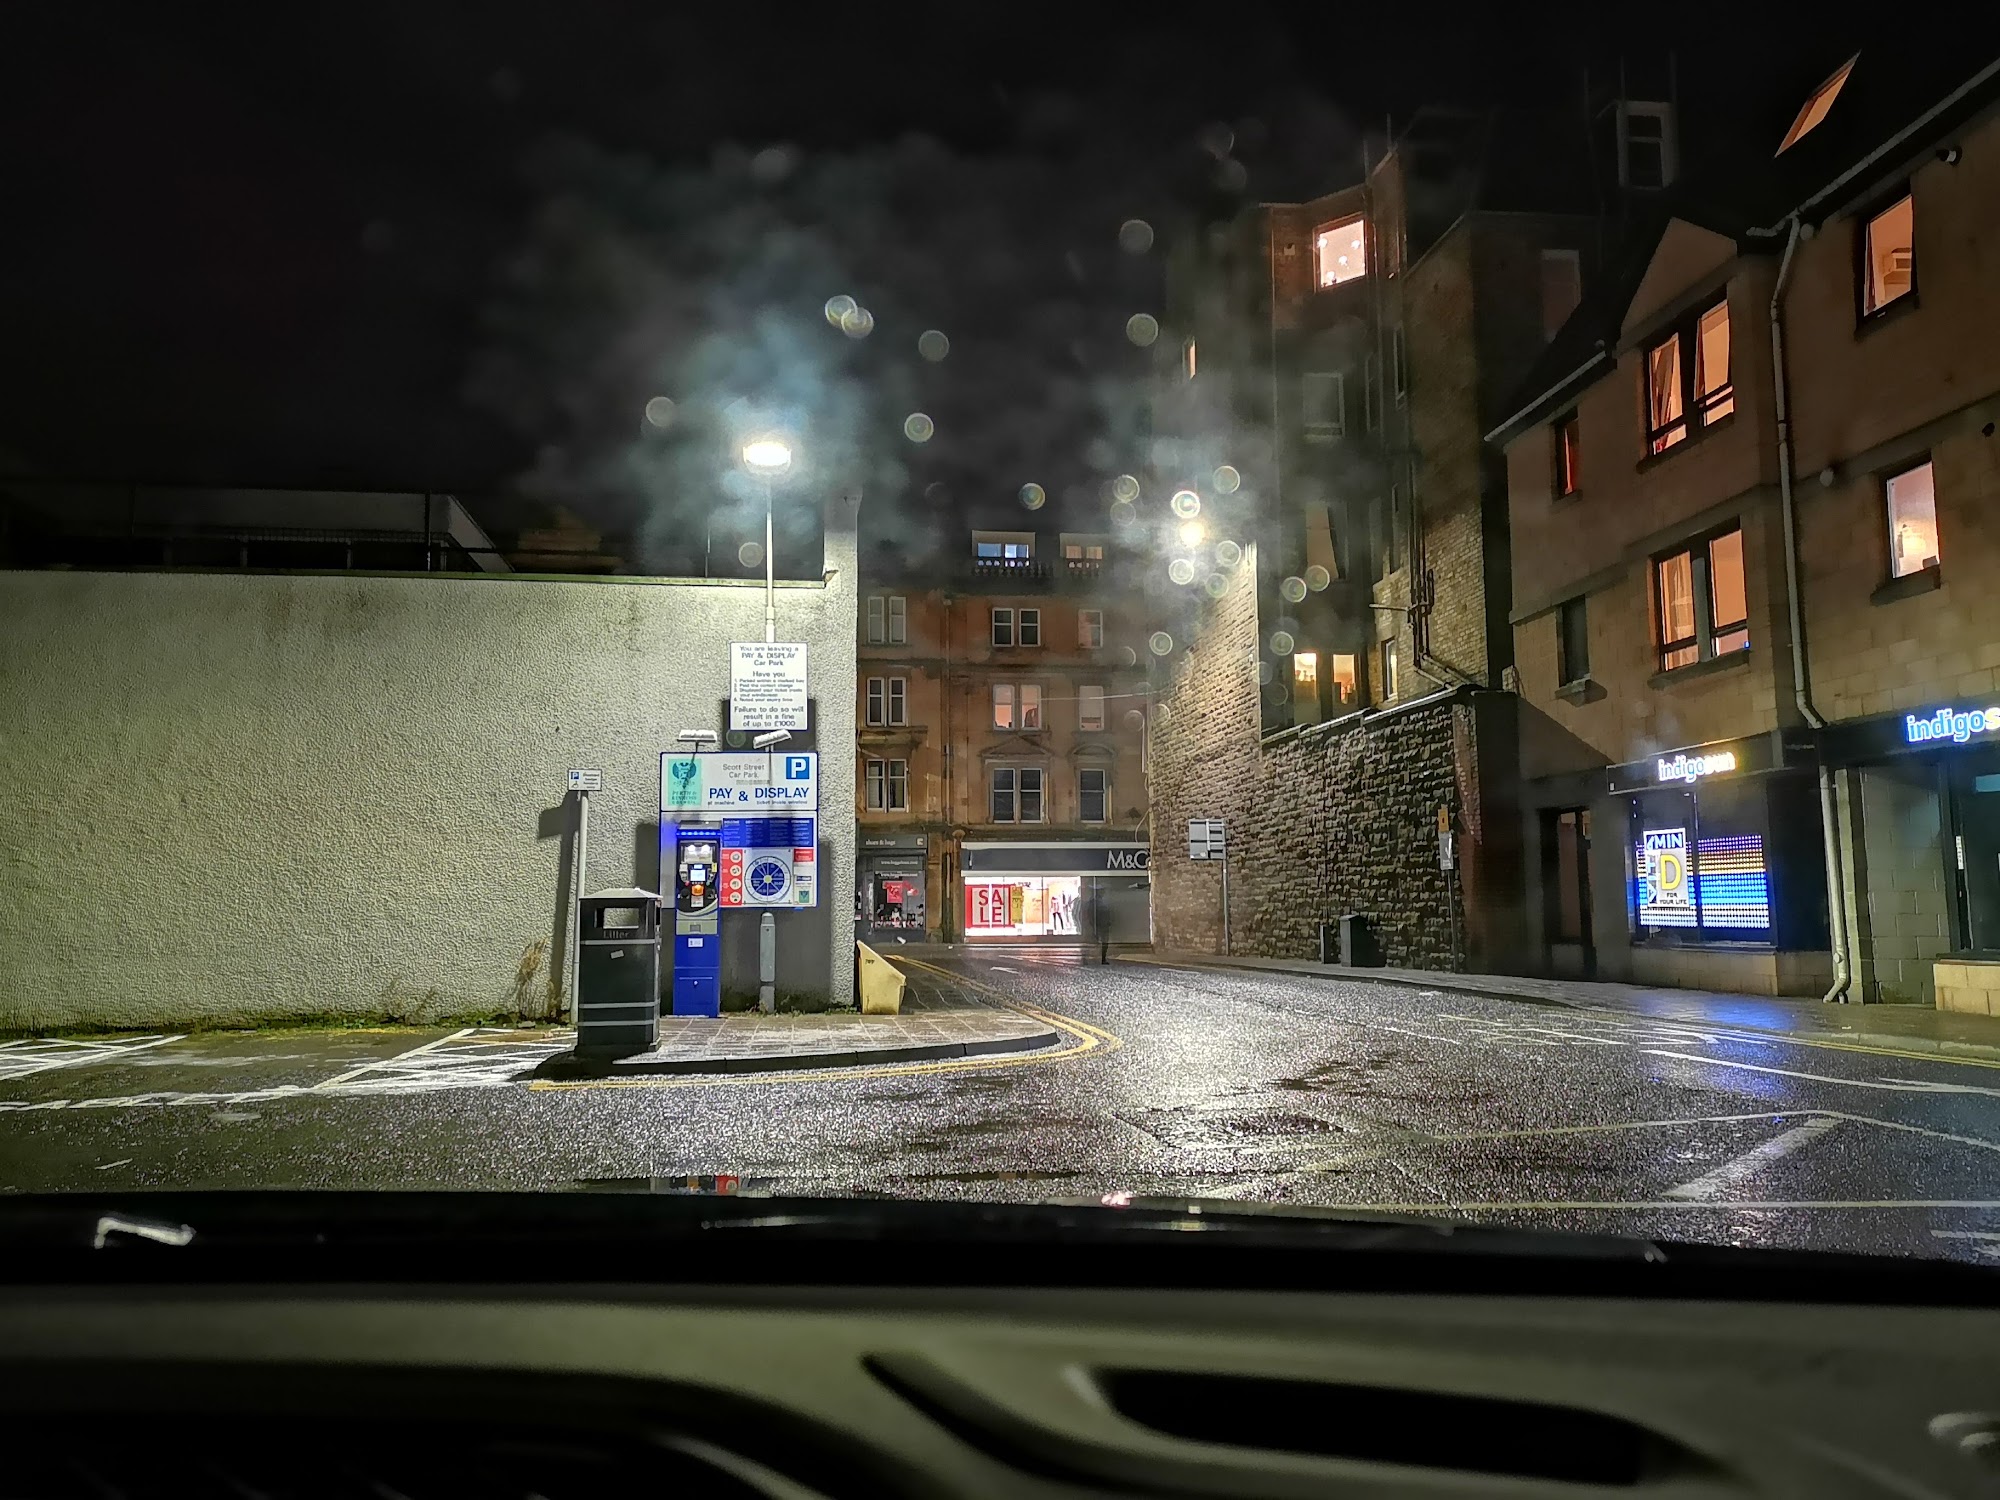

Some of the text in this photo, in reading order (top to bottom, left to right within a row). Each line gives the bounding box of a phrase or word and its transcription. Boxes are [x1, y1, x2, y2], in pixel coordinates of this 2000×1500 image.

[791, 759, 806, 778] P
[709, 787, 809, 801] PAY & DISPLAY
[1660, 854, 1682, 890] D
